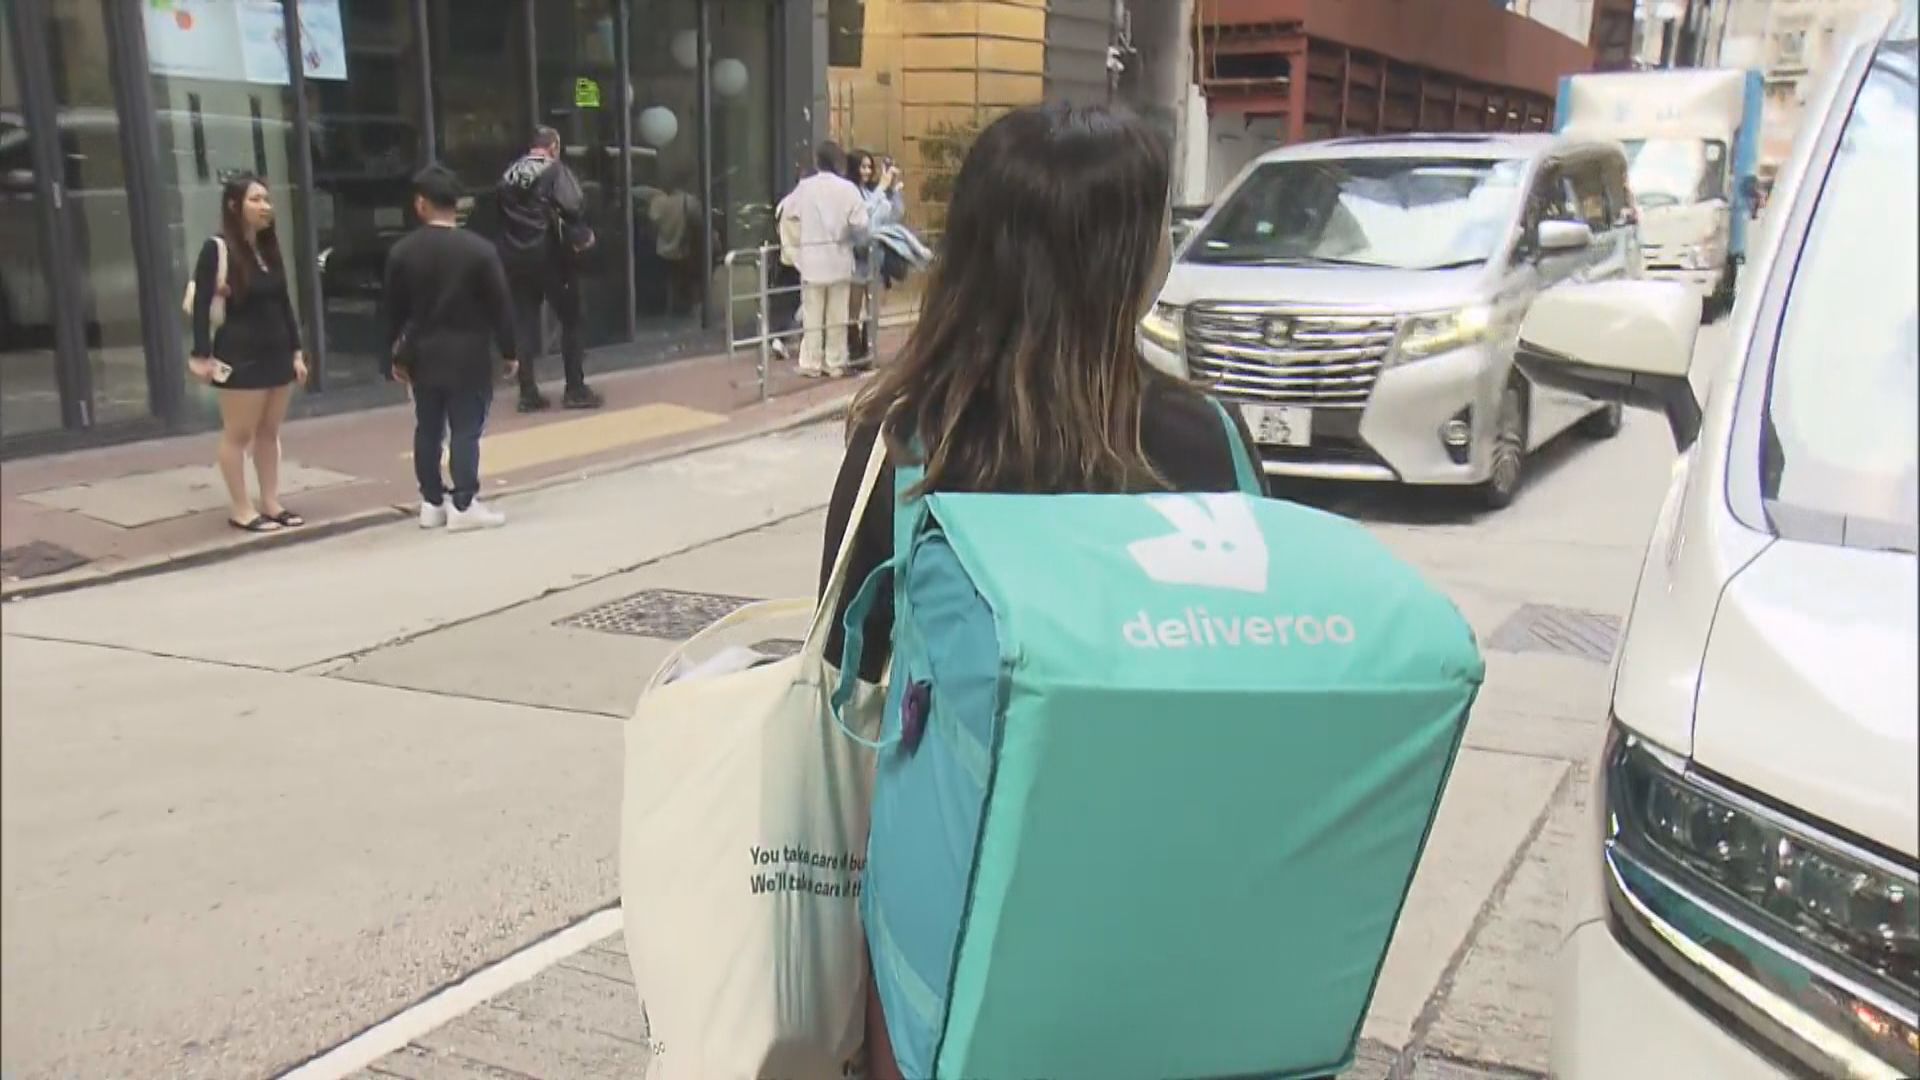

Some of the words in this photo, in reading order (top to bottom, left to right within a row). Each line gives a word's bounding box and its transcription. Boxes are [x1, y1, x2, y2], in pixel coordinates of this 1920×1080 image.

[1122, 604, 1356, 649] deliveroo
[750, 846, 779, 865] You
[783, 844, 810, 864] take
[811, 853, 838, 869] care
[751, 872, 786, 894] We'll
